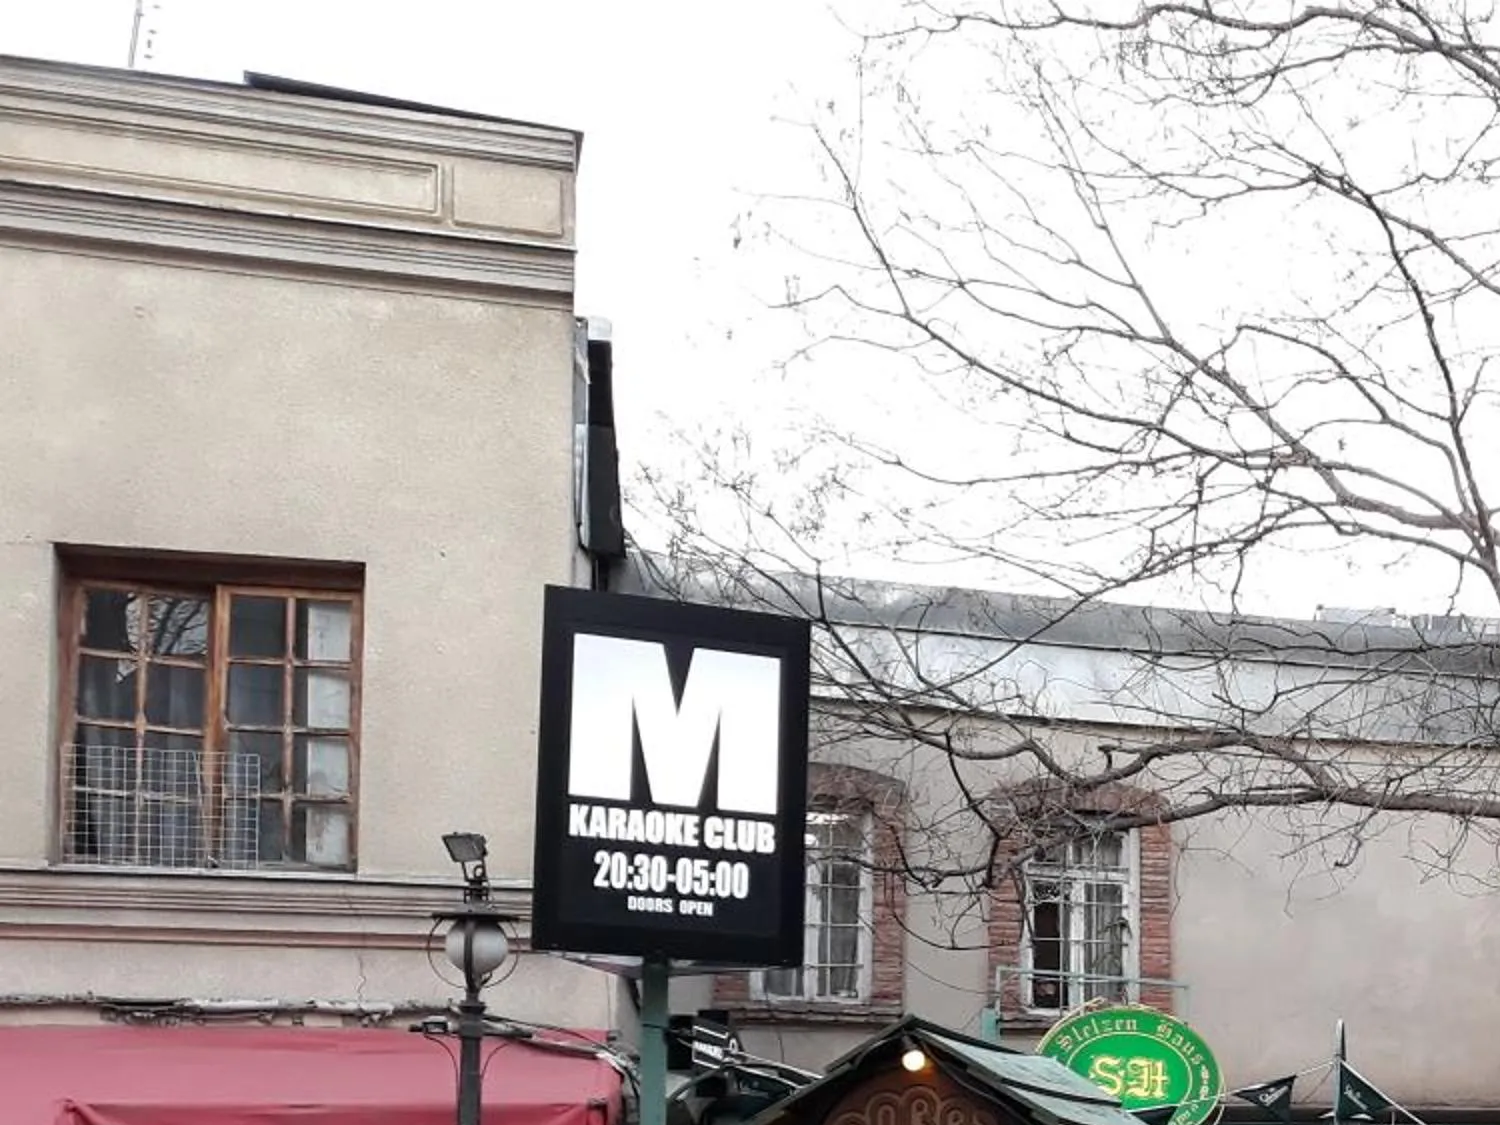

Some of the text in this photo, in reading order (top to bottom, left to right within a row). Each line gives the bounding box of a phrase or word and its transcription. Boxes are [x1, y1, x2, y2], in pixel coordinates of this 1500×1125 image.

[567, 632, 782, 814] M
[568, 803, 775, 854] KARAOKE CLUB
[593, 849, 749, 900] 20:30-05:00
[627, 894, 714, 917] DOORS OPEN
